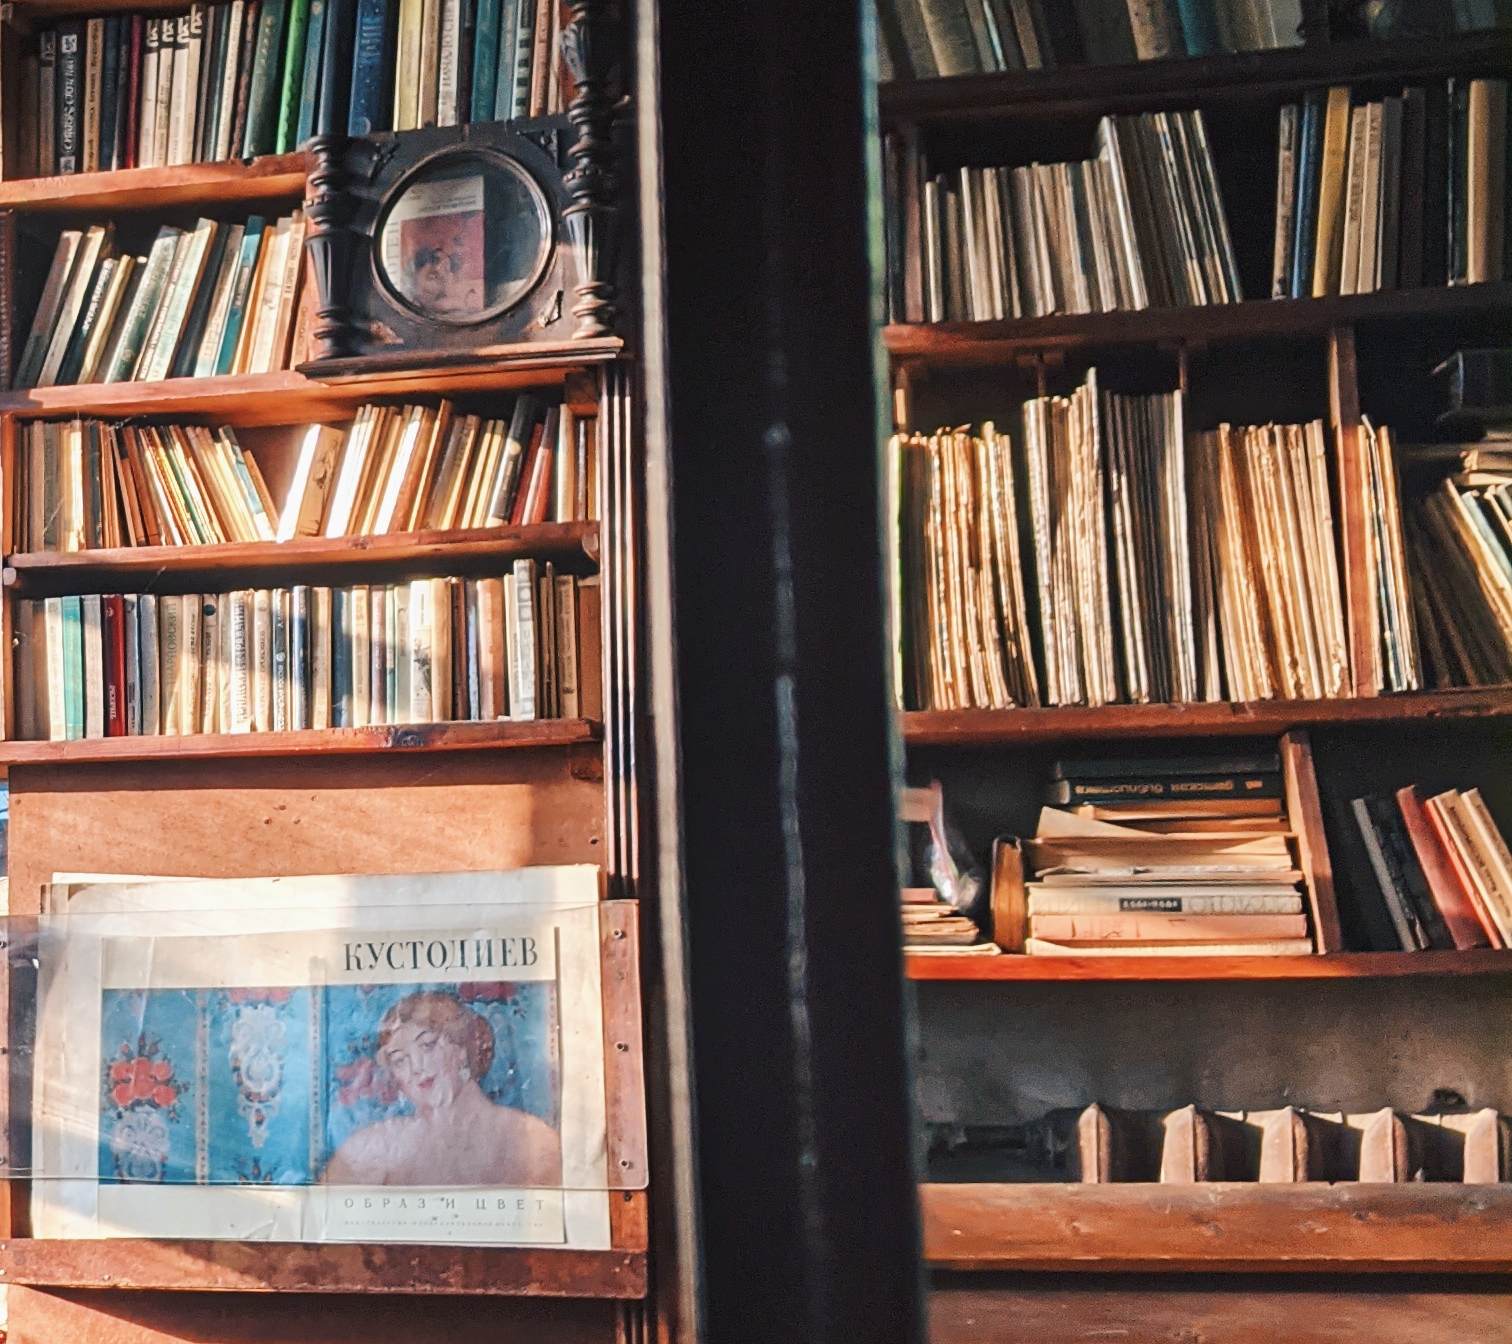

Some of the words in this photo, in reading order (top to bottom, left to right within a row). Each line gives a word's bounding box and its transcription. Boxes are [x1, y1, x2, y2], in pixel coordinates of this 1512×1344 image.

[343, 936, 538, 973] КУСТОДИЕВ
[344, 1197, 427, 1210] ОБРАЗ
[445, 1198, 456, 1210] И
[475, 1198, 545, 1211] ЦВЕТ
